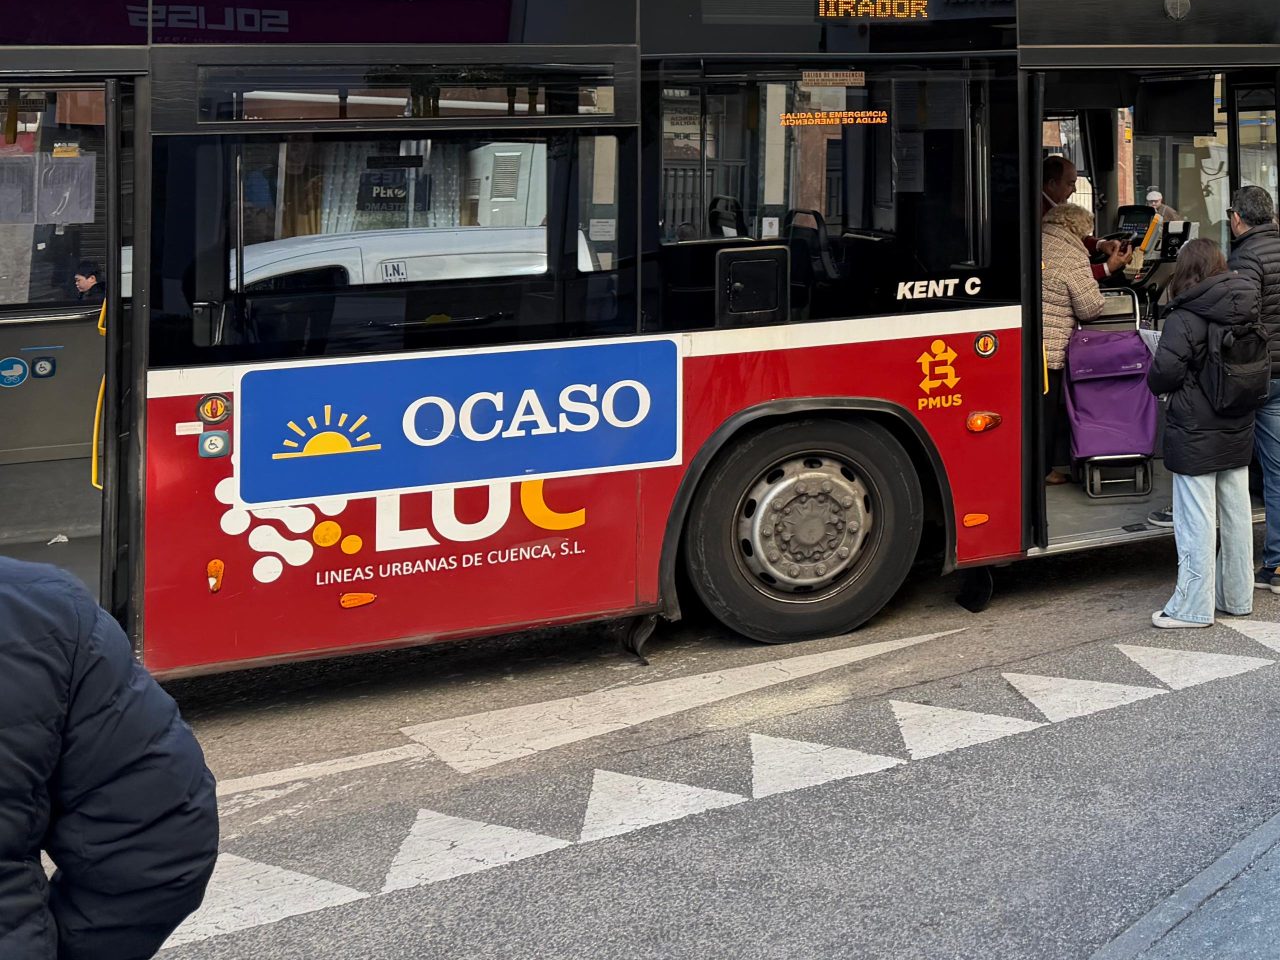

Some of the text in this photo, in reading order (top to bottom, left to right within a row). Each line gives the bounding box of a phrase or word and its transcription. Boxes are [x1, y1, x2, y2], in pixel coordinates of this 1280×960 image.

[779, 110, 888, 120] SALIDA DE EMERGENCIA
[896, 277, 982, 300] KENT C
[402, 379, 651, 447] OCASO
[918, 393, 963, 410] PMUS
[315, 540, 586, 586] LINEAS URBANAS DE CUENCA, S.L.
